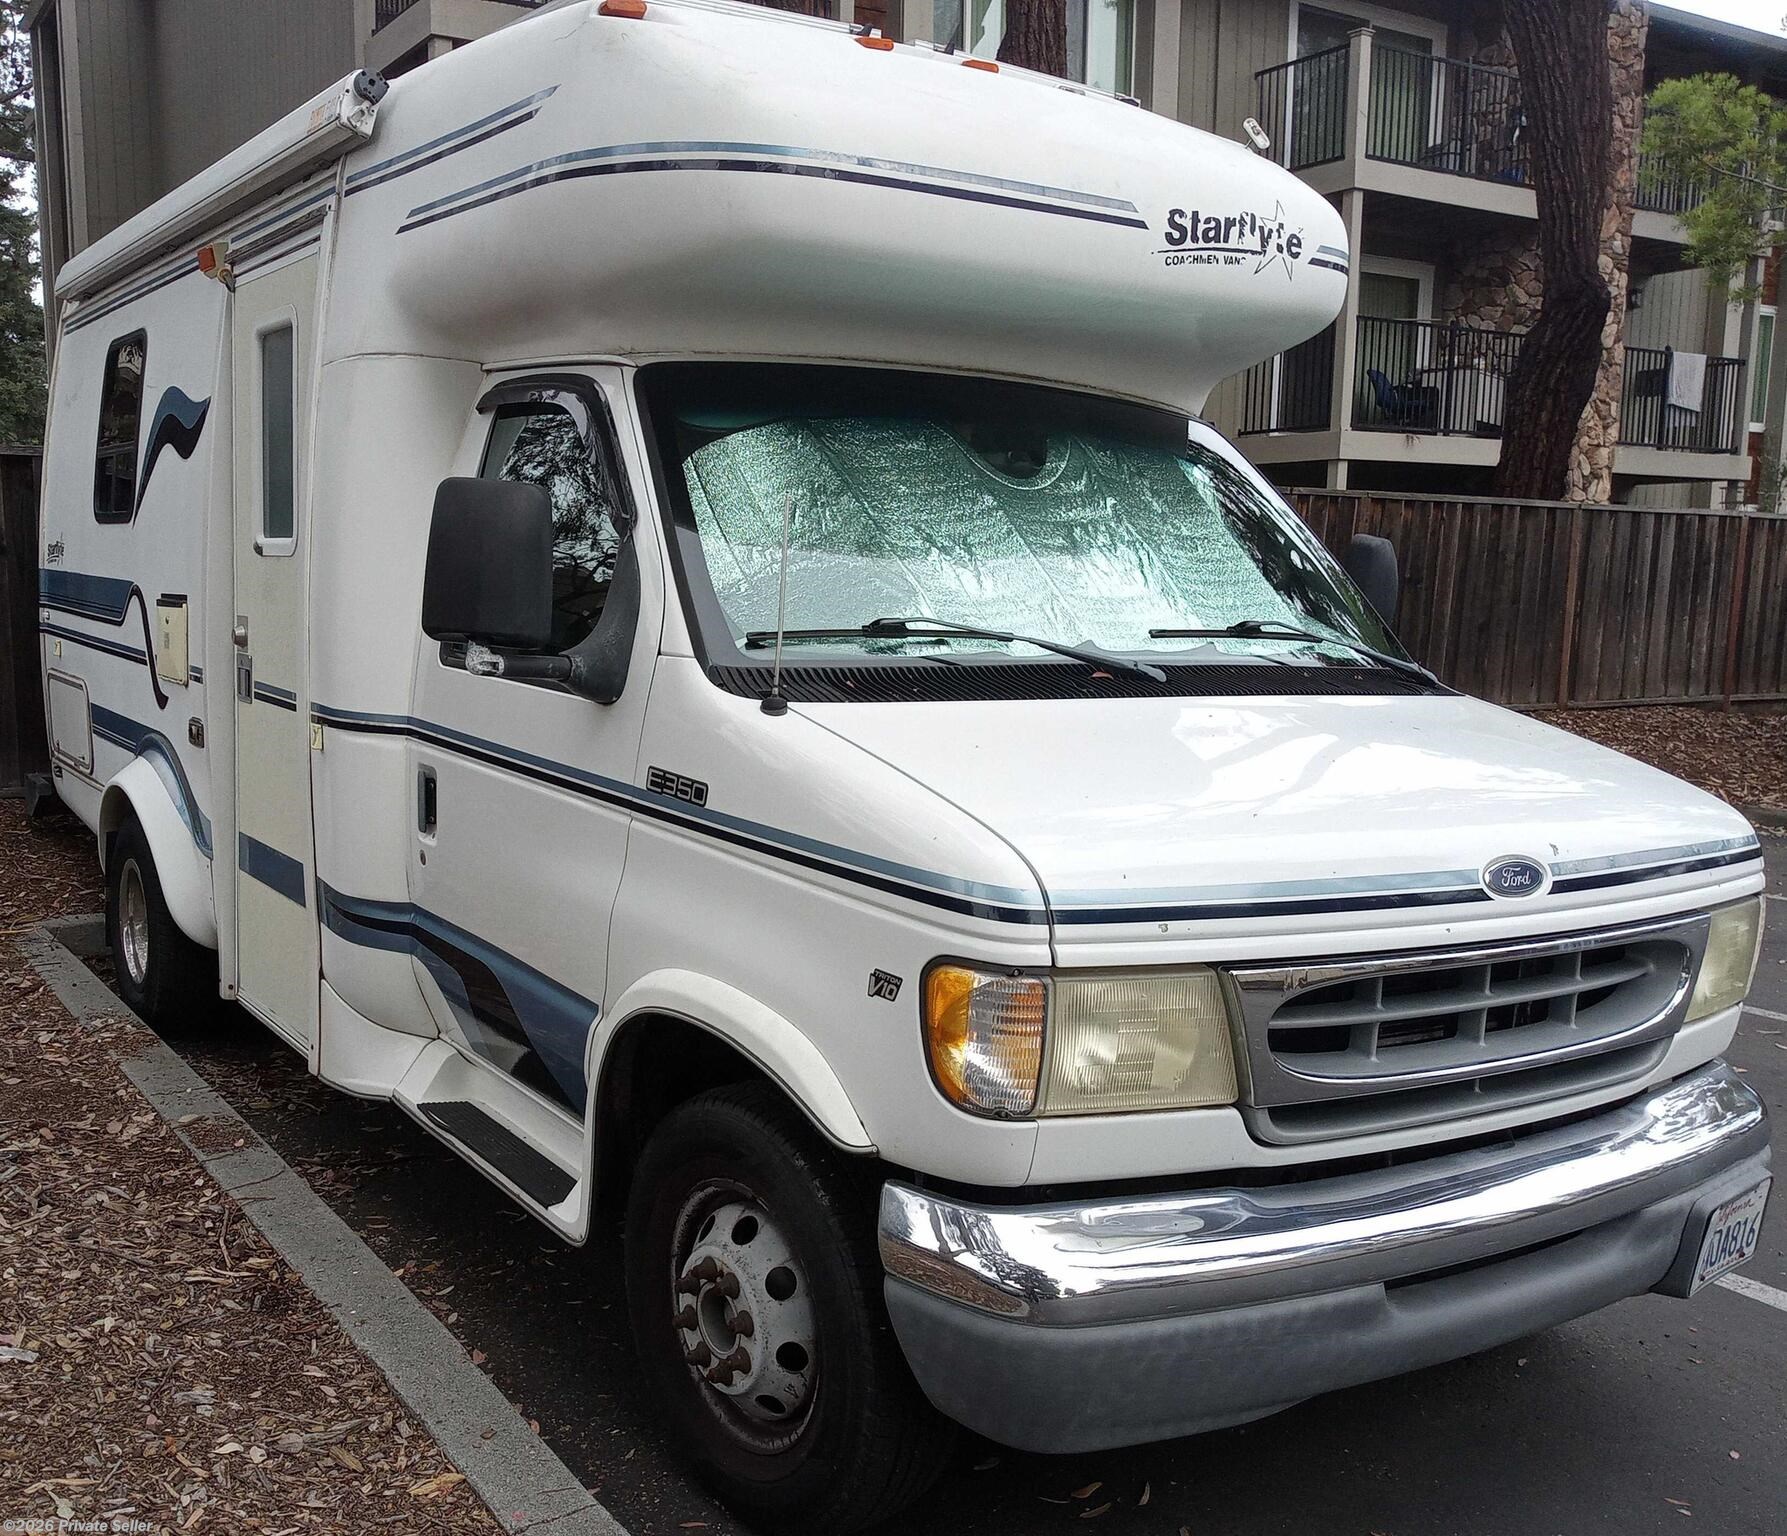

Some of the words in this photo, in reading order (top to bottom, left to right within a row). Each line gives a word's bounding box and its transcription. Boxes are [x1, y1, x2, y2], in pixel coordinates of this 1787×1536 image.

[1165, 254, 1219, 266] COACHMEN
[1501, 866, 1531, 887] Ford
[874, 970, 901, 985] TRITON
[869, 975, 898, 1001] V10
